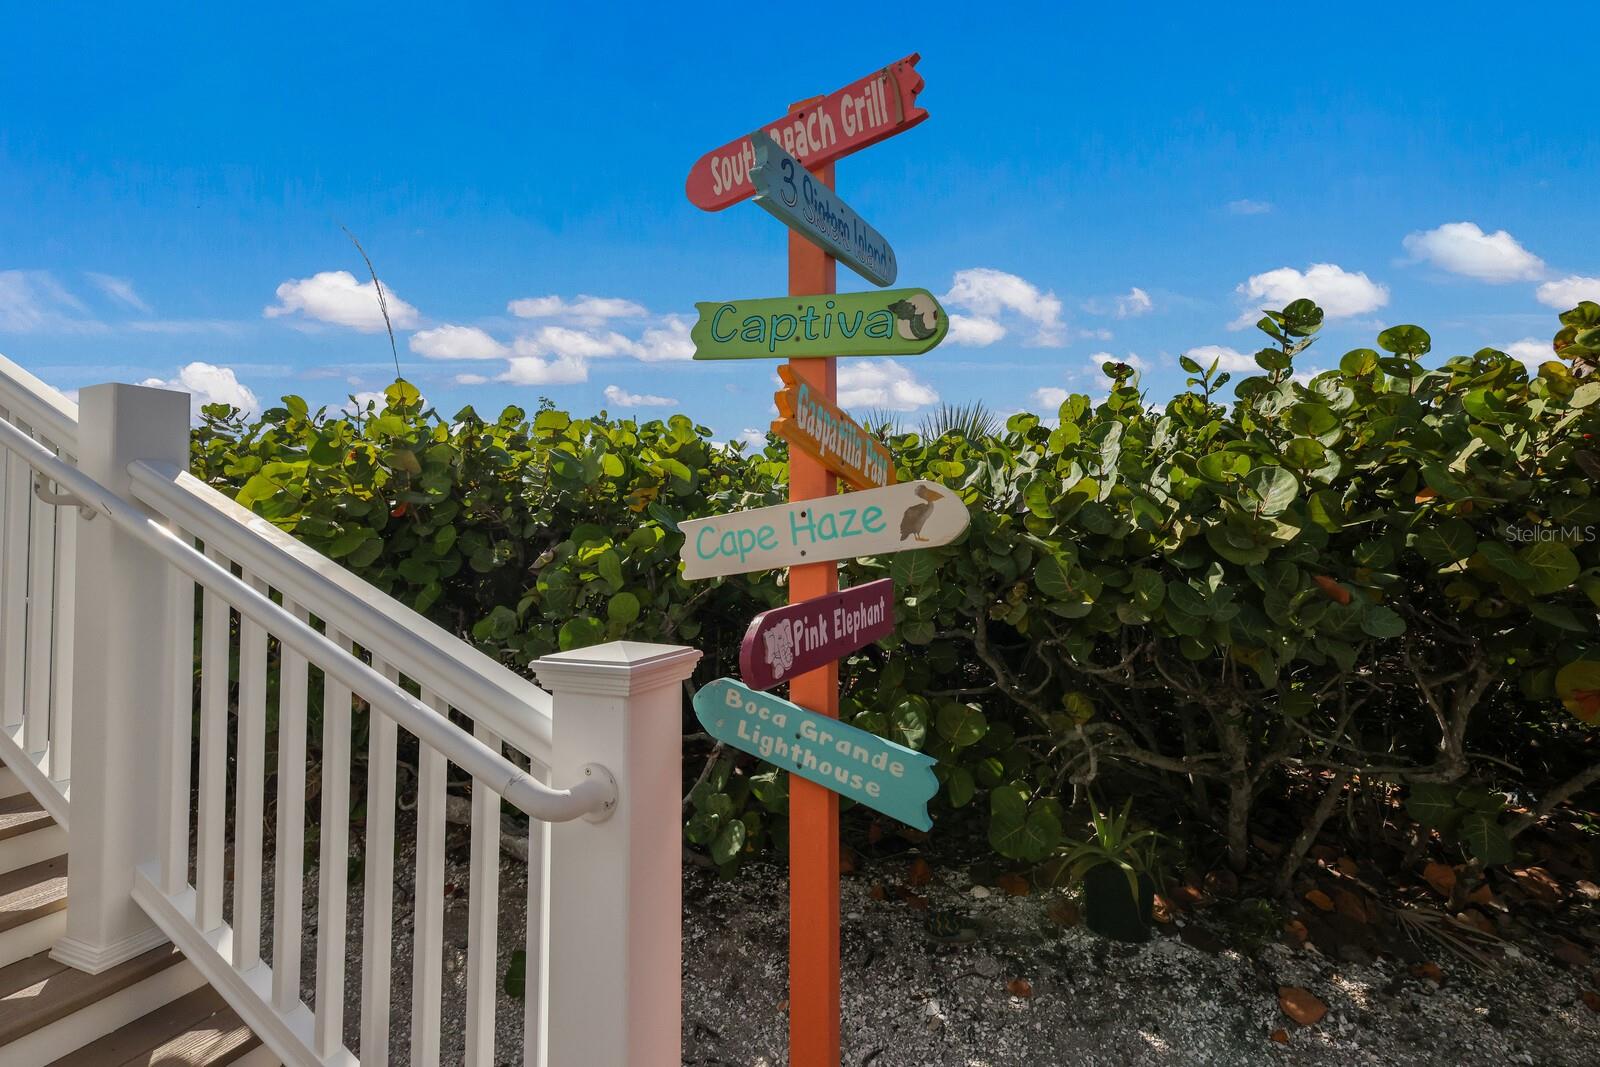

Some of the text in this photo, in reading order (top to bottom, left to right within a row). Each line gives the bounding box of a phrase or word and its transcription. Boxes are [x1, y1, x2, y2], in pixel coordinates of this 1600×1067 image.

[711, 141, 756, 196] Sout
[840, 77, 889, 137] Grill
[780, 158, 798, 208] 3
[711, 300, 894, 352] Captiva
[797, 383, 862, 471] Gasparilla
[696, 505, 887, 563] Cape Haze
[793, 595, 885, 657] Pink Elephant
[725, 688, 905, 778] Boca Grande
[736, 720, 881, 798] Lighthouse
